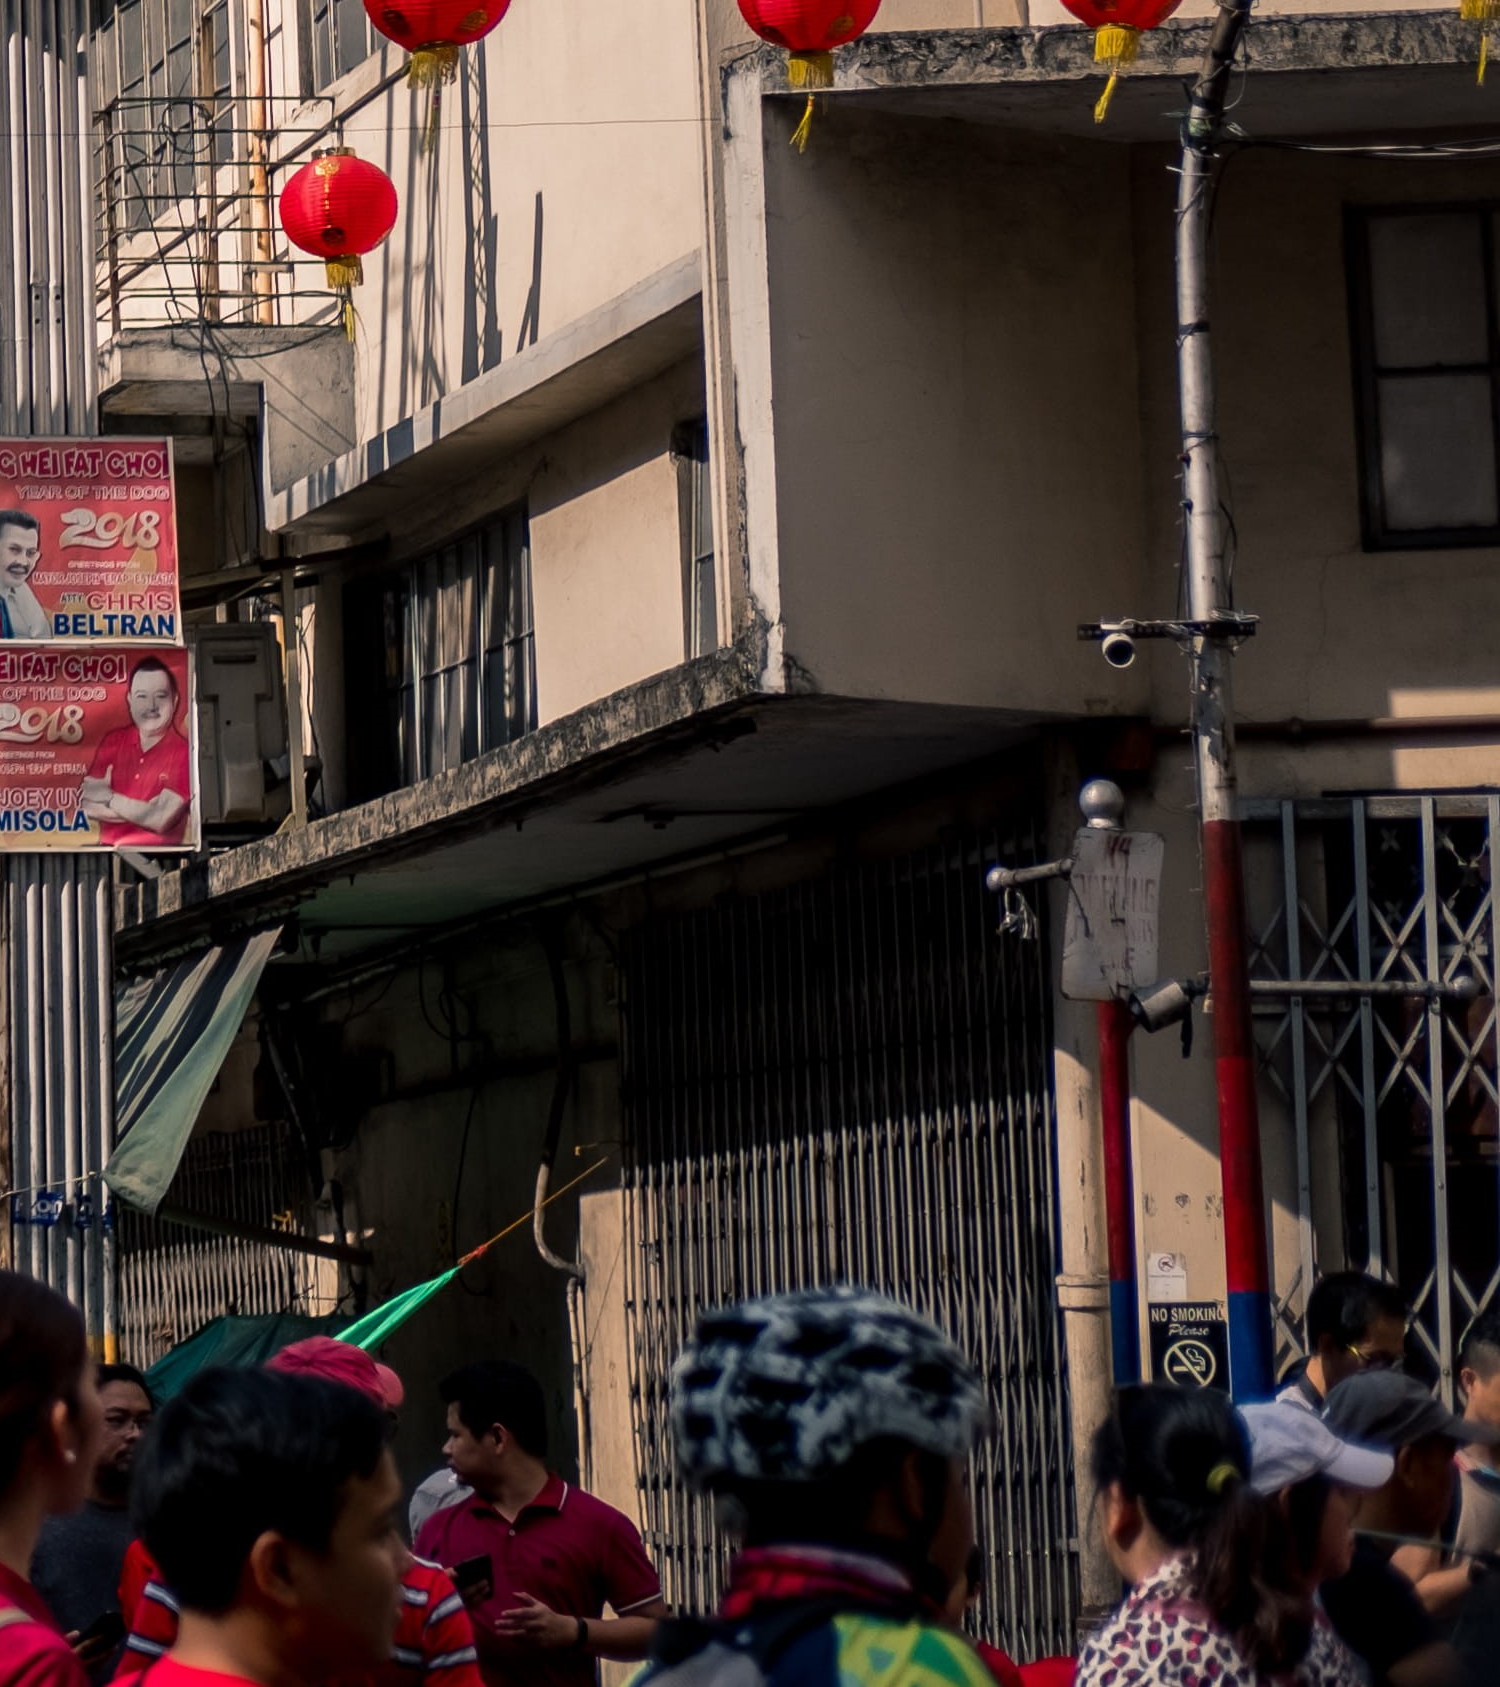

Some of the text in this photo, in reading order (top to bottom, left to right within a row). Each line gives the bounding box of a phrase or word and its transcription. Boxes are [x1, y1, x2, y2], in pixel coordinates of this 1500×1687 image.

[21, 449, 63, 477] HEI
[64, 448, 102, 476] FAT
[102, 449, 170, 479] CHOI
[15, 484, 170, 501] YEAR OF THE DOG
[60, 508, 161, 550] 2018
[87, 591, 173, 610] CHRIS
[54, 614, 175, 636] BELTRAN
[20, 654, 60, 680] FAT
[62, 654, 127, 683] CHOI
[4, 687, 27, 702] OF
[29, 687, 64, 702] THE
[66, 687, 107, 702] DOG
[57, 787, 84, 808] UY
[1151, 1307, 1168, 1322] NO
[1168, 1323, 1210, 1337] Please
